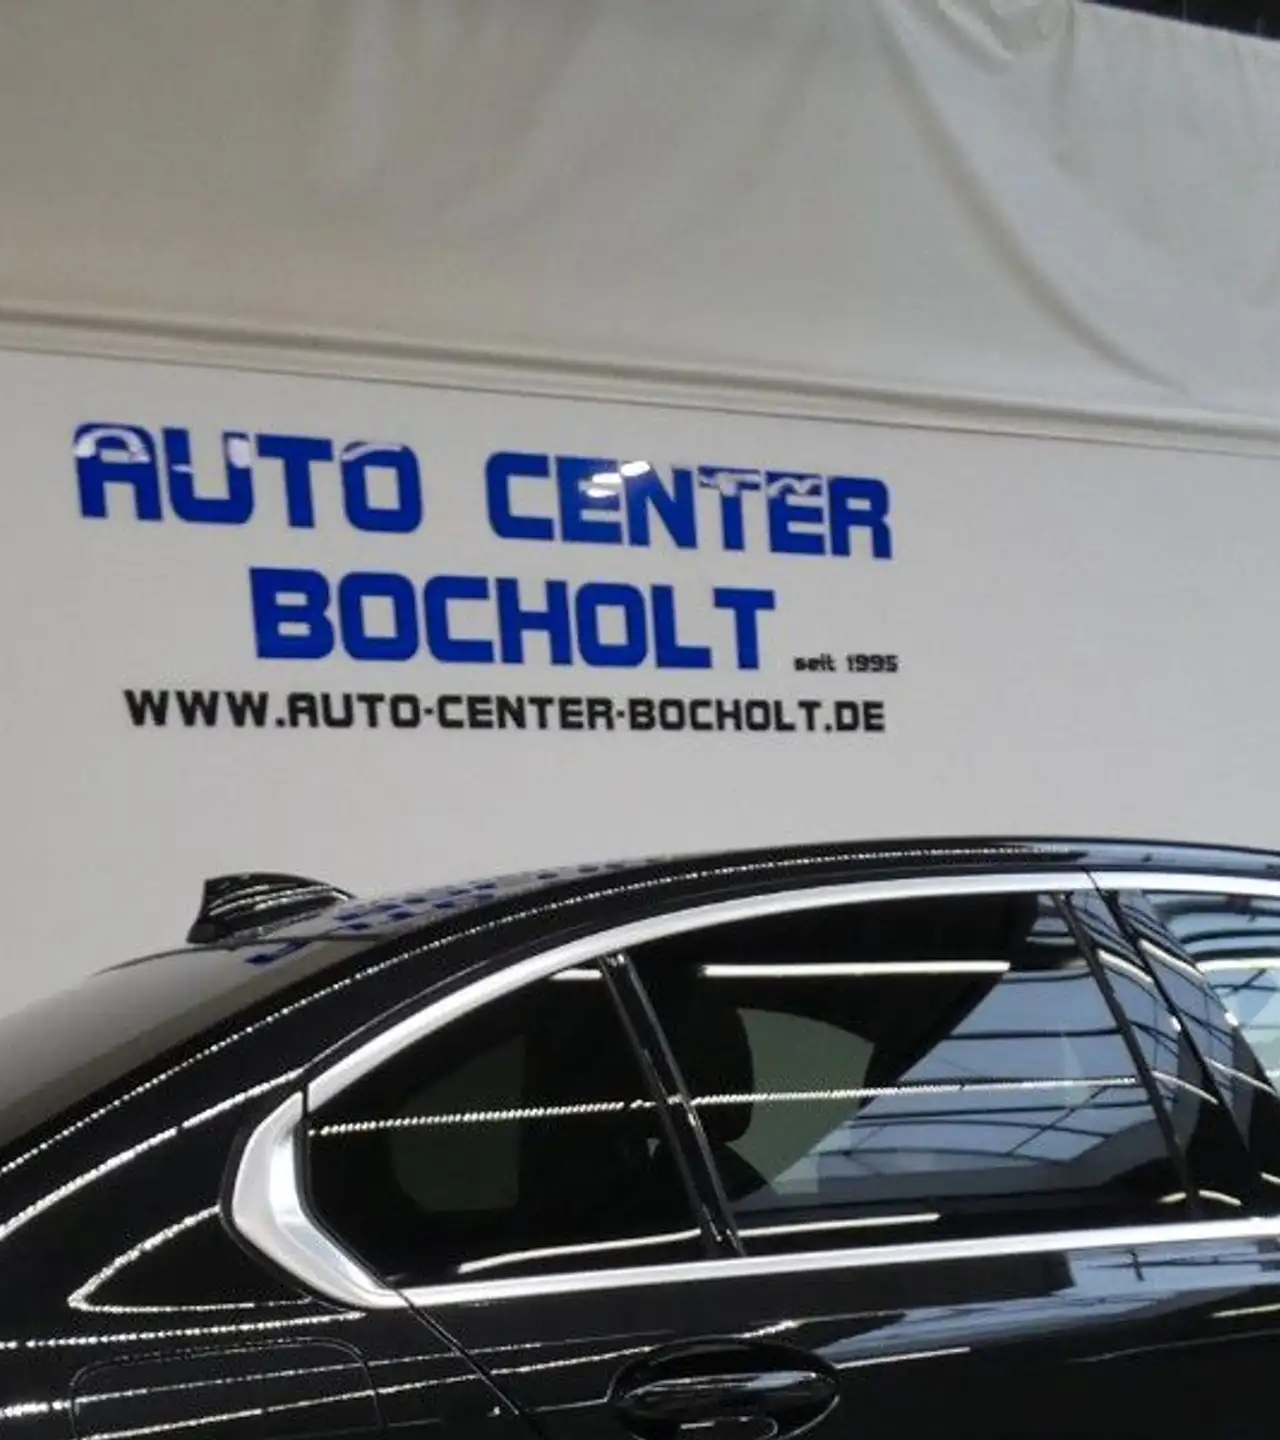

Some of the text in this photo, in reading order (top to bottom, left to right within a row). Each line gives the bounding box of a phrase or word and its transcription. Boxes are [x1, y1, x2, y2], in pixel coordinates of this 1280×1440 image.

[73, 422, 892, 560] AUTO CENTER
[248, 566, 776, 671] BOCHOLT
[793, 653, 899, 674] seit 1995
[123, 689, 886, 732] WWW.AUTO-CENTER-BOCHOLT.DE
